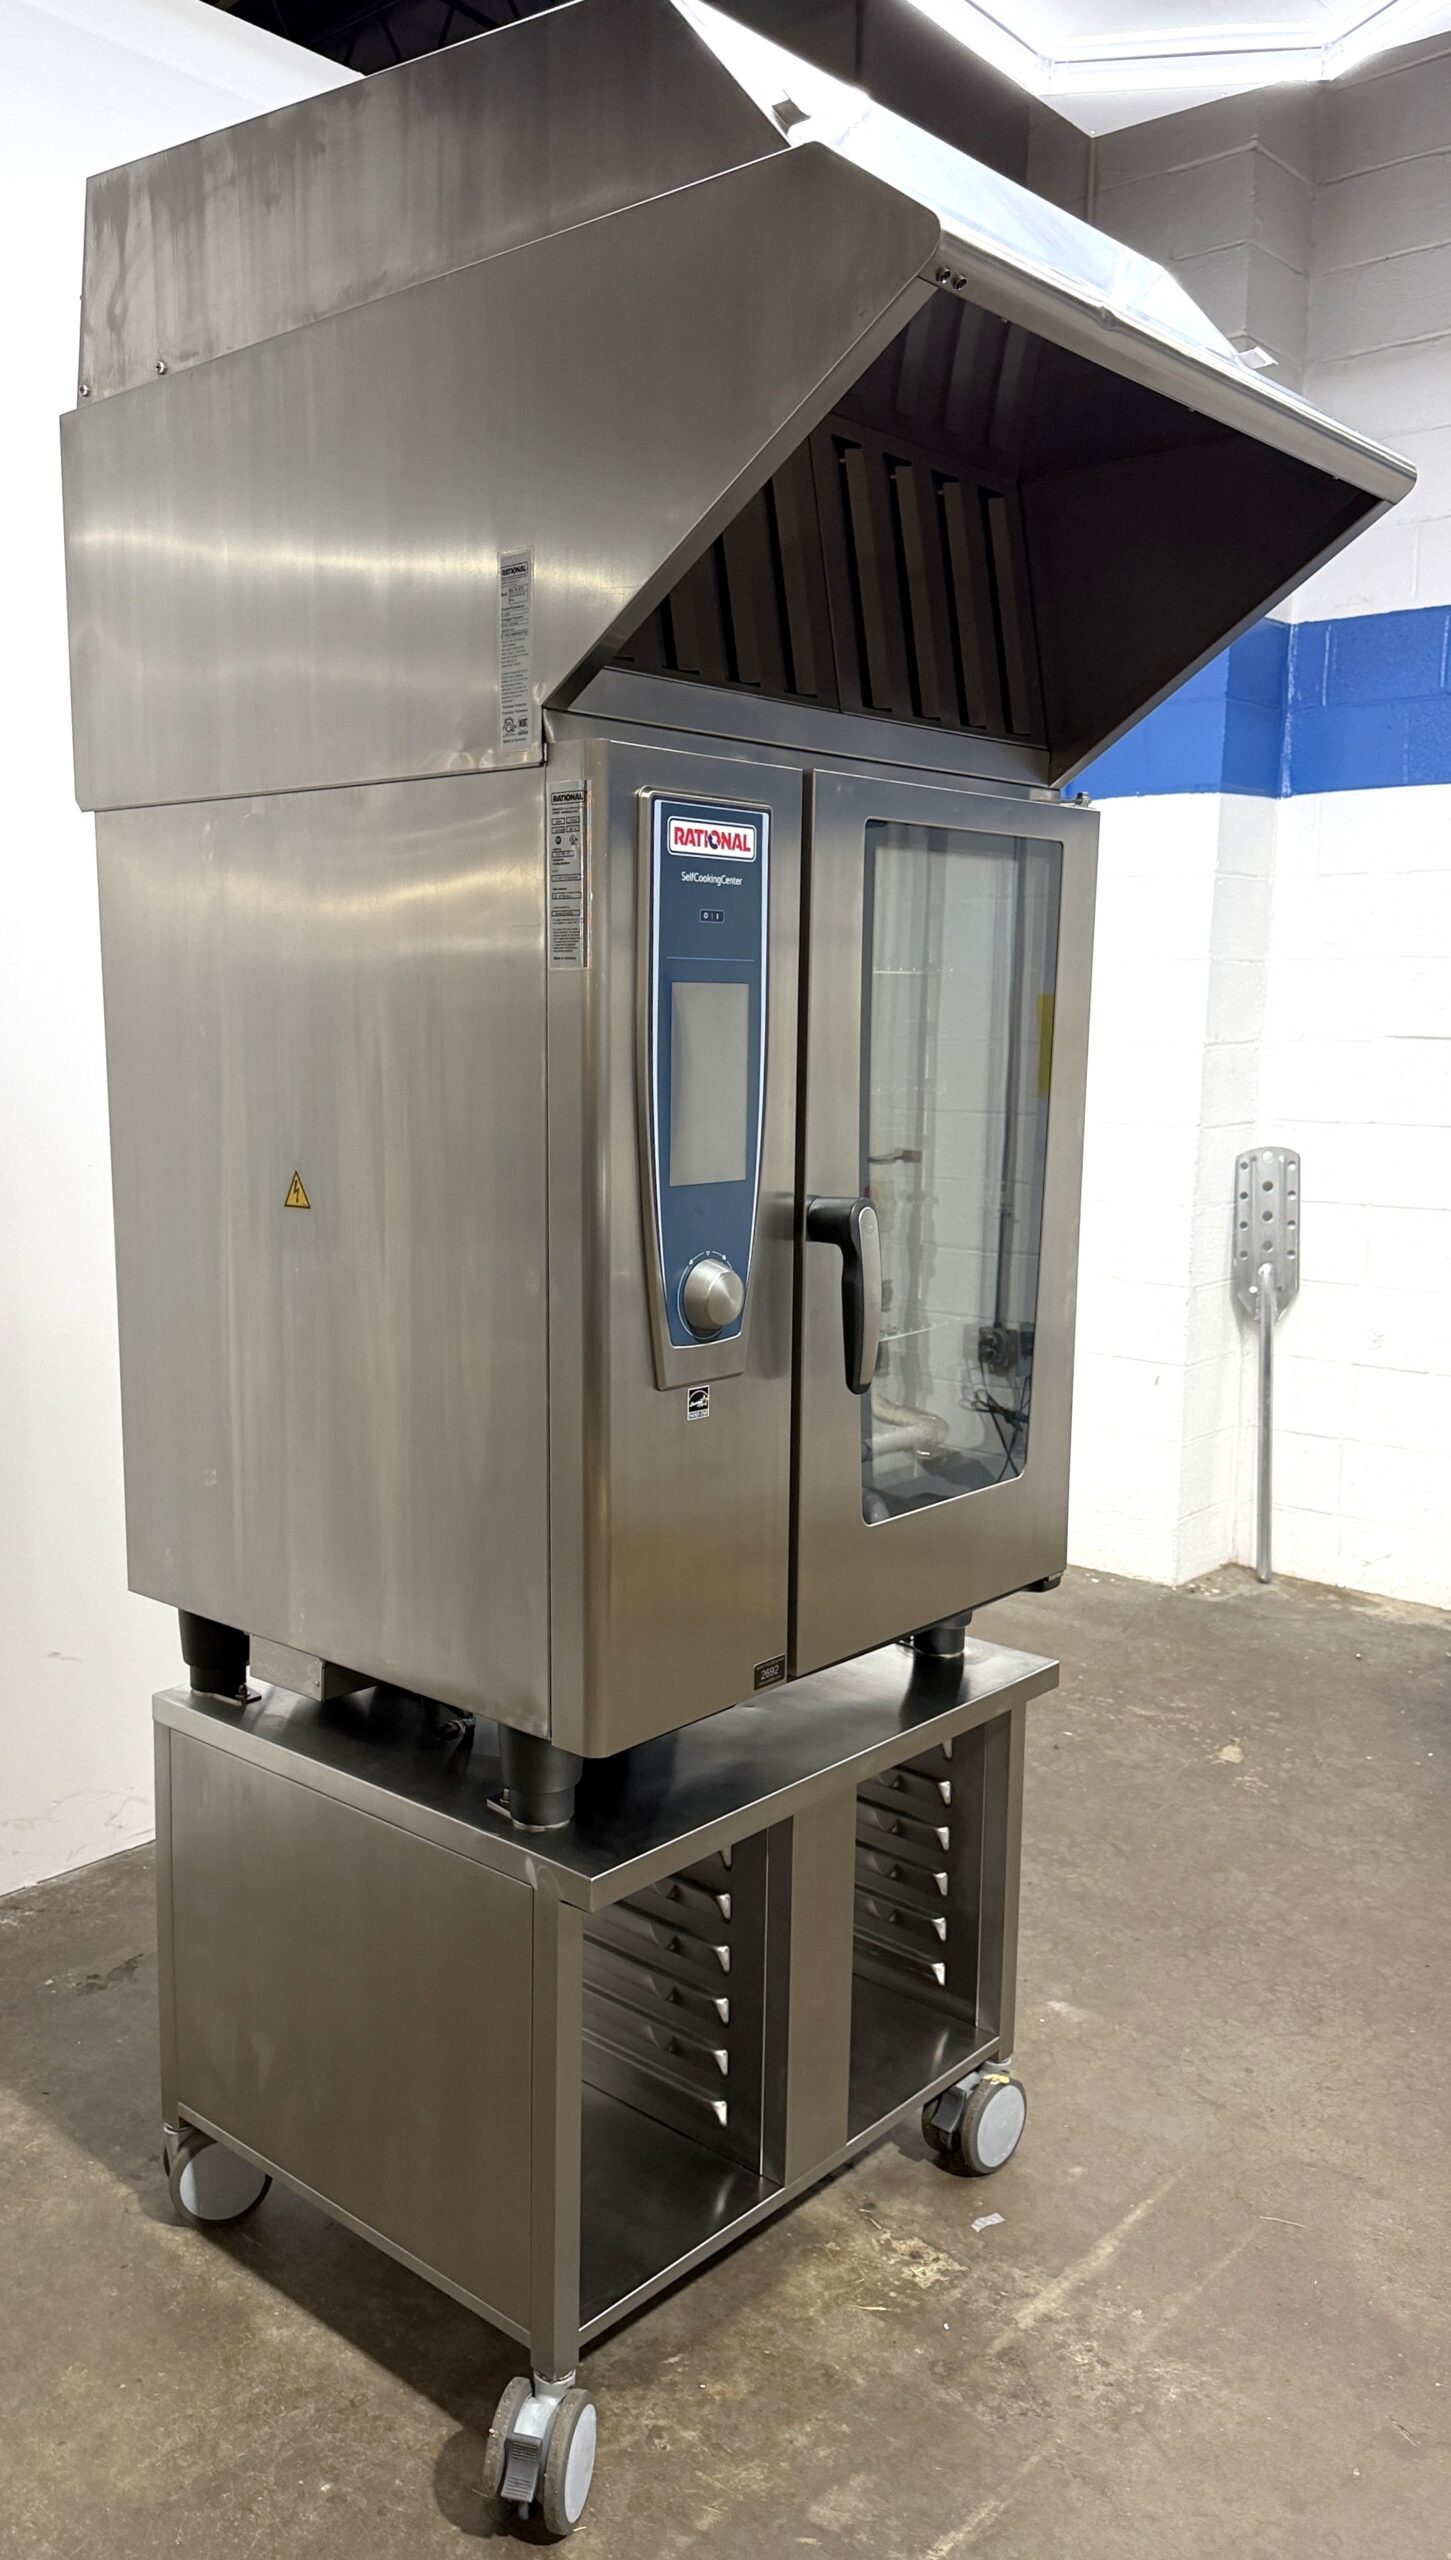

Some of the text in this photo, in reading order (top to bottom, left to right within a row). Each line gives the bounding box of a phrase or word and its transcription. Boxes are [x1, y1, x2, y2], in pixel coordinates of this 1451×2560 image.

[553, 793, 583, 802] RATIONAL
[674, 826, 752, 852] RATIONAL
[681, 871, 743, 886] SelfCookingCenter
